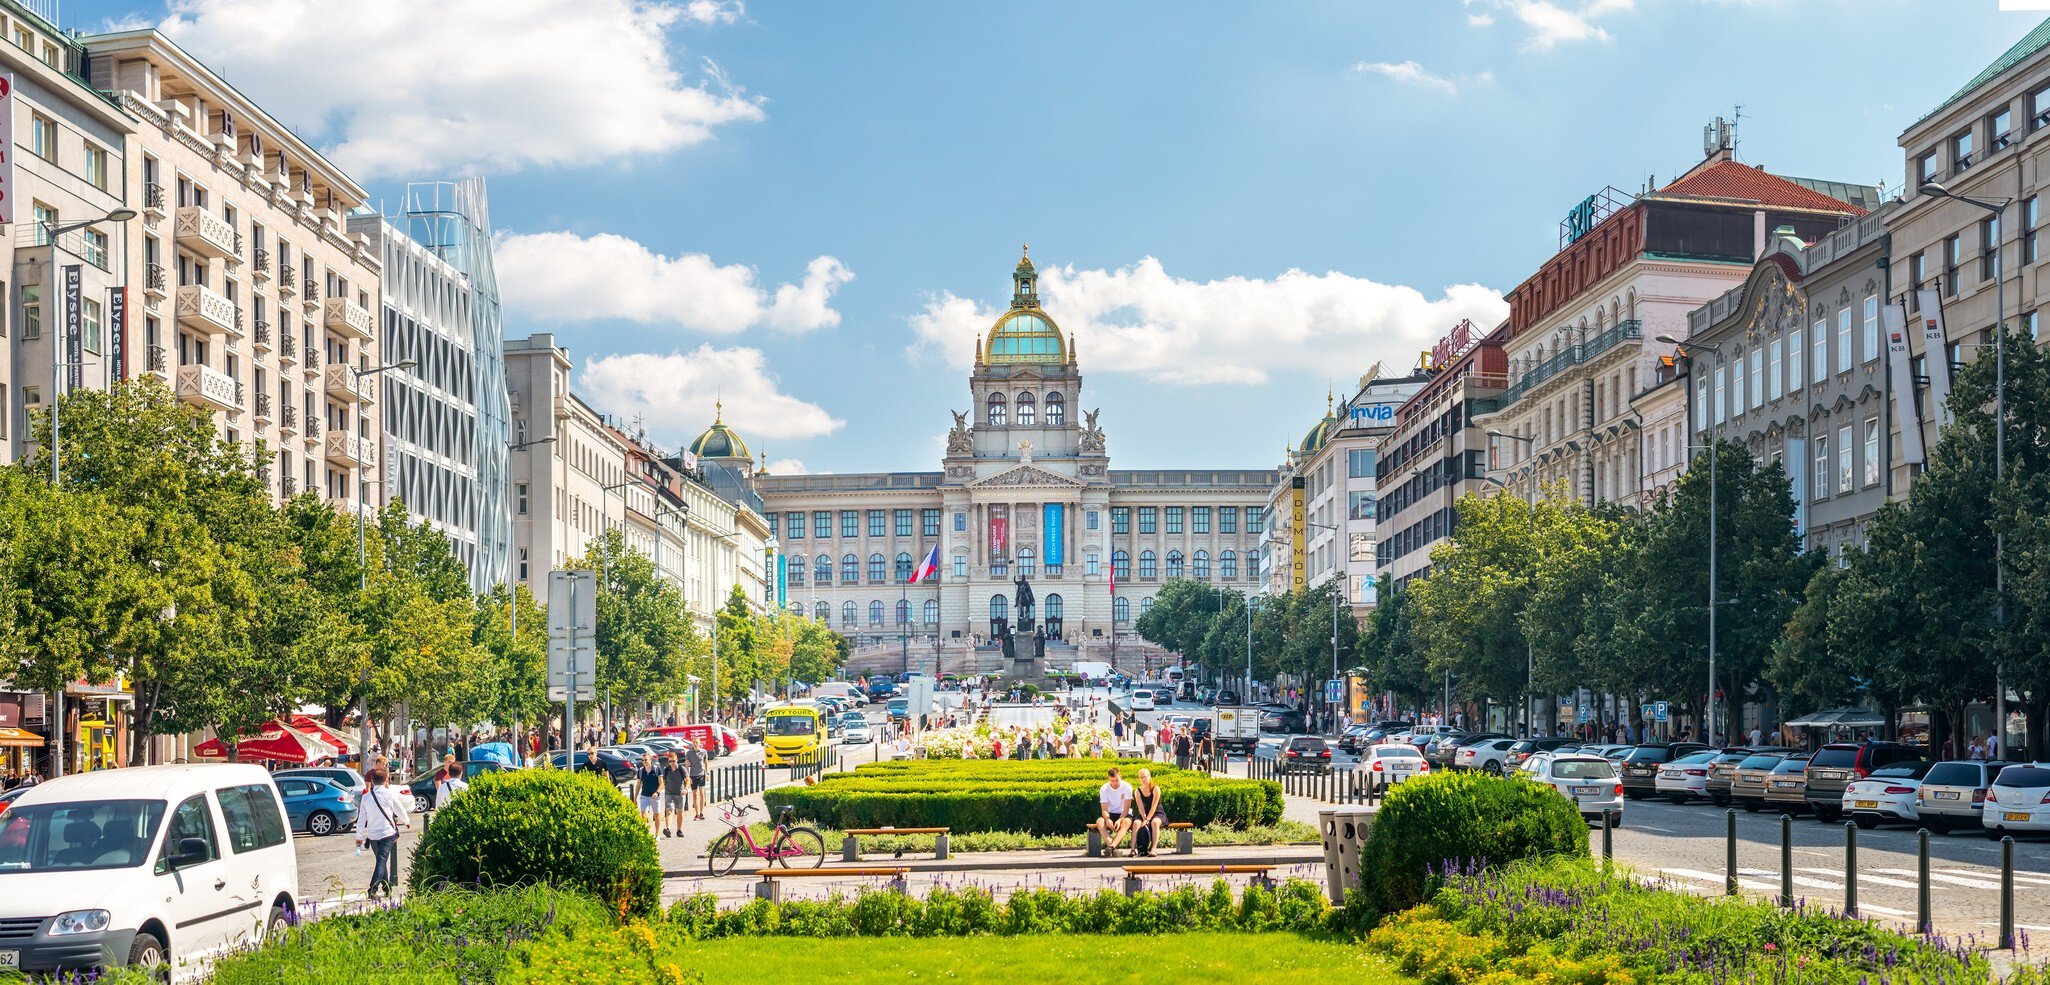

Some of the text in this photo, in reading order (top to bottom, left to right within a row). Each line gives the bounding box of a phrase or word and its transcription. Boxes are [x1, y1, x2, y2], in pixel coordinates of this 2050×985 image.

[221, 109, 336, 212] HOTEL
[1568, 194, 1596, 243] SZIF
[67, 271, 79, 335] Elysee
[111, 293, 123, 355] Elysee
[1925, 332, 1941, 340] KB
[1349, 402, 1393, 420] invia
[1294, 548, 1304, 594] MÓD
[0, 953, 13, 965] 62
